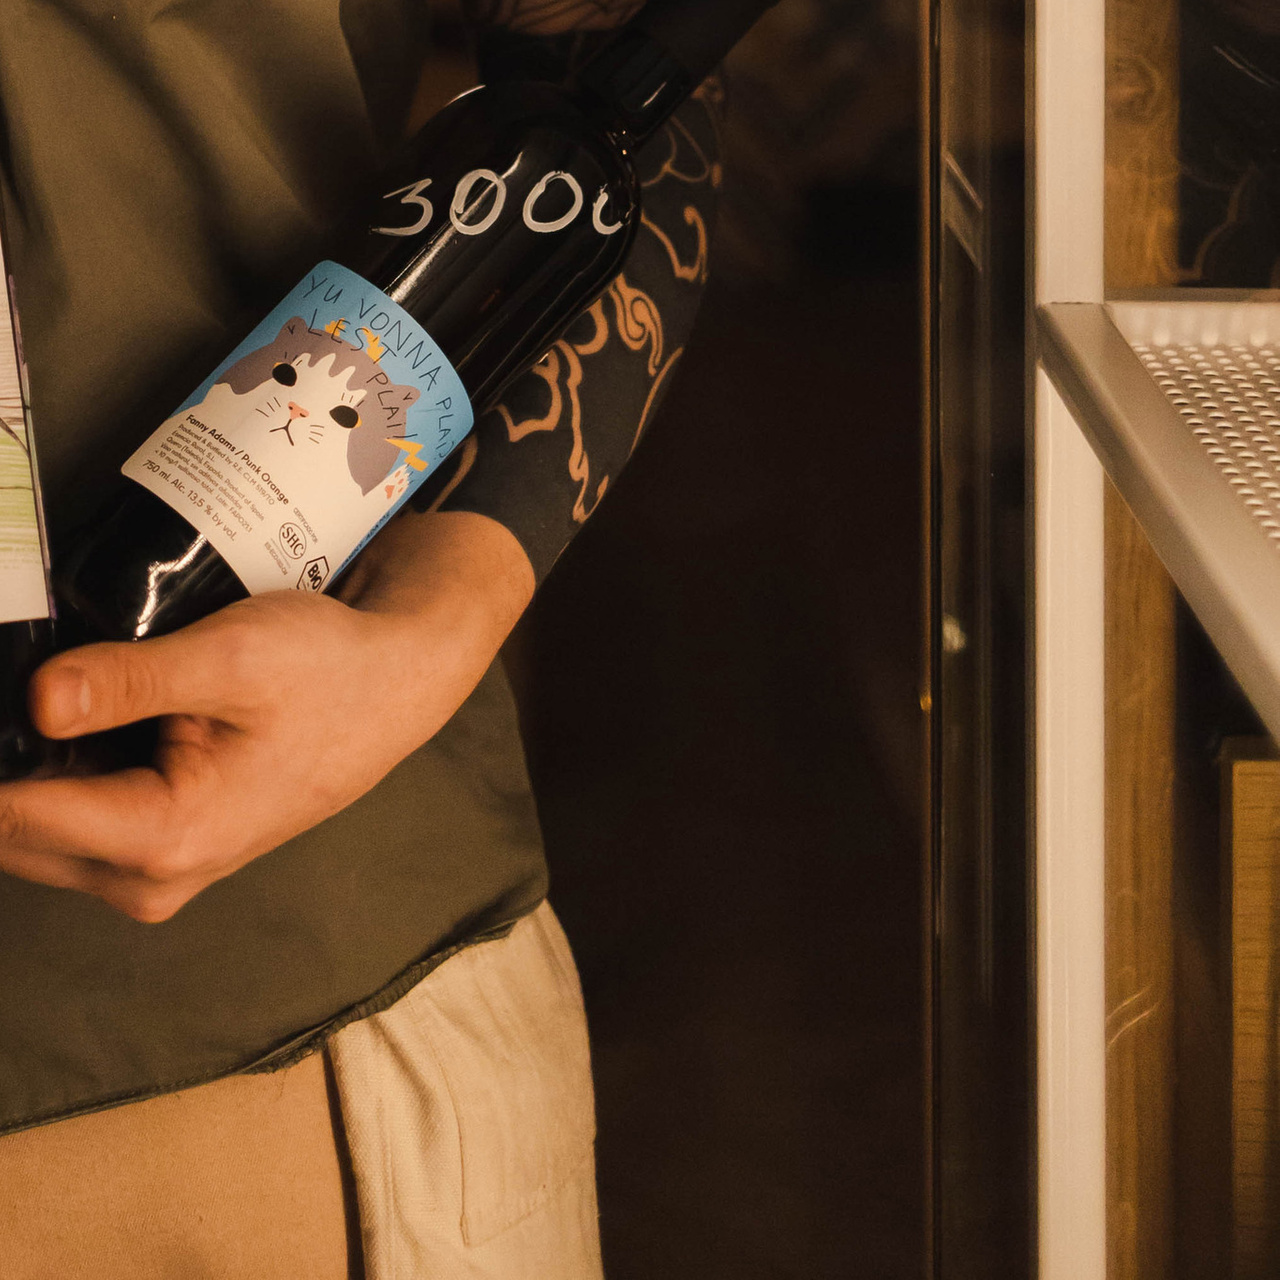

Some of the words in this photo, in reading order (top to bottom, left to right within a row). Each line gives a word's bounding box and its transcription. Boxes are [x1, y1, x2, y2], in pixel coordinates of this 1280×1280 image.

[303, 275, 343, 305] YU
[360, 298, 442, 391] VONNA
[185, 413, 210, 433] Fanny
[207, 428, 237, 453] Adams
[233, 448, 245, 457] /
[240, 453, 262, 475] Punk
[260, 472, 290, 506] Orange
[224, 455, 233, 465] by
[242, 471, 258, 486] CLM
[142, 459, 161, 473] 750
[158, 470, 172, 483] ml.
[170, 478, 186, 495] Alc.
[186, 489, 206, 508] 13,5
[203, 504, 214, 516] %
[211, 512, 224, 527] by
[222, 524, 238, 542] vol.
[223, 477, 246, 500] Product
[243, 497, 253, 506] of
[249, 503, 265, 522] Spain
[282, 527, 304, 555] SHC
